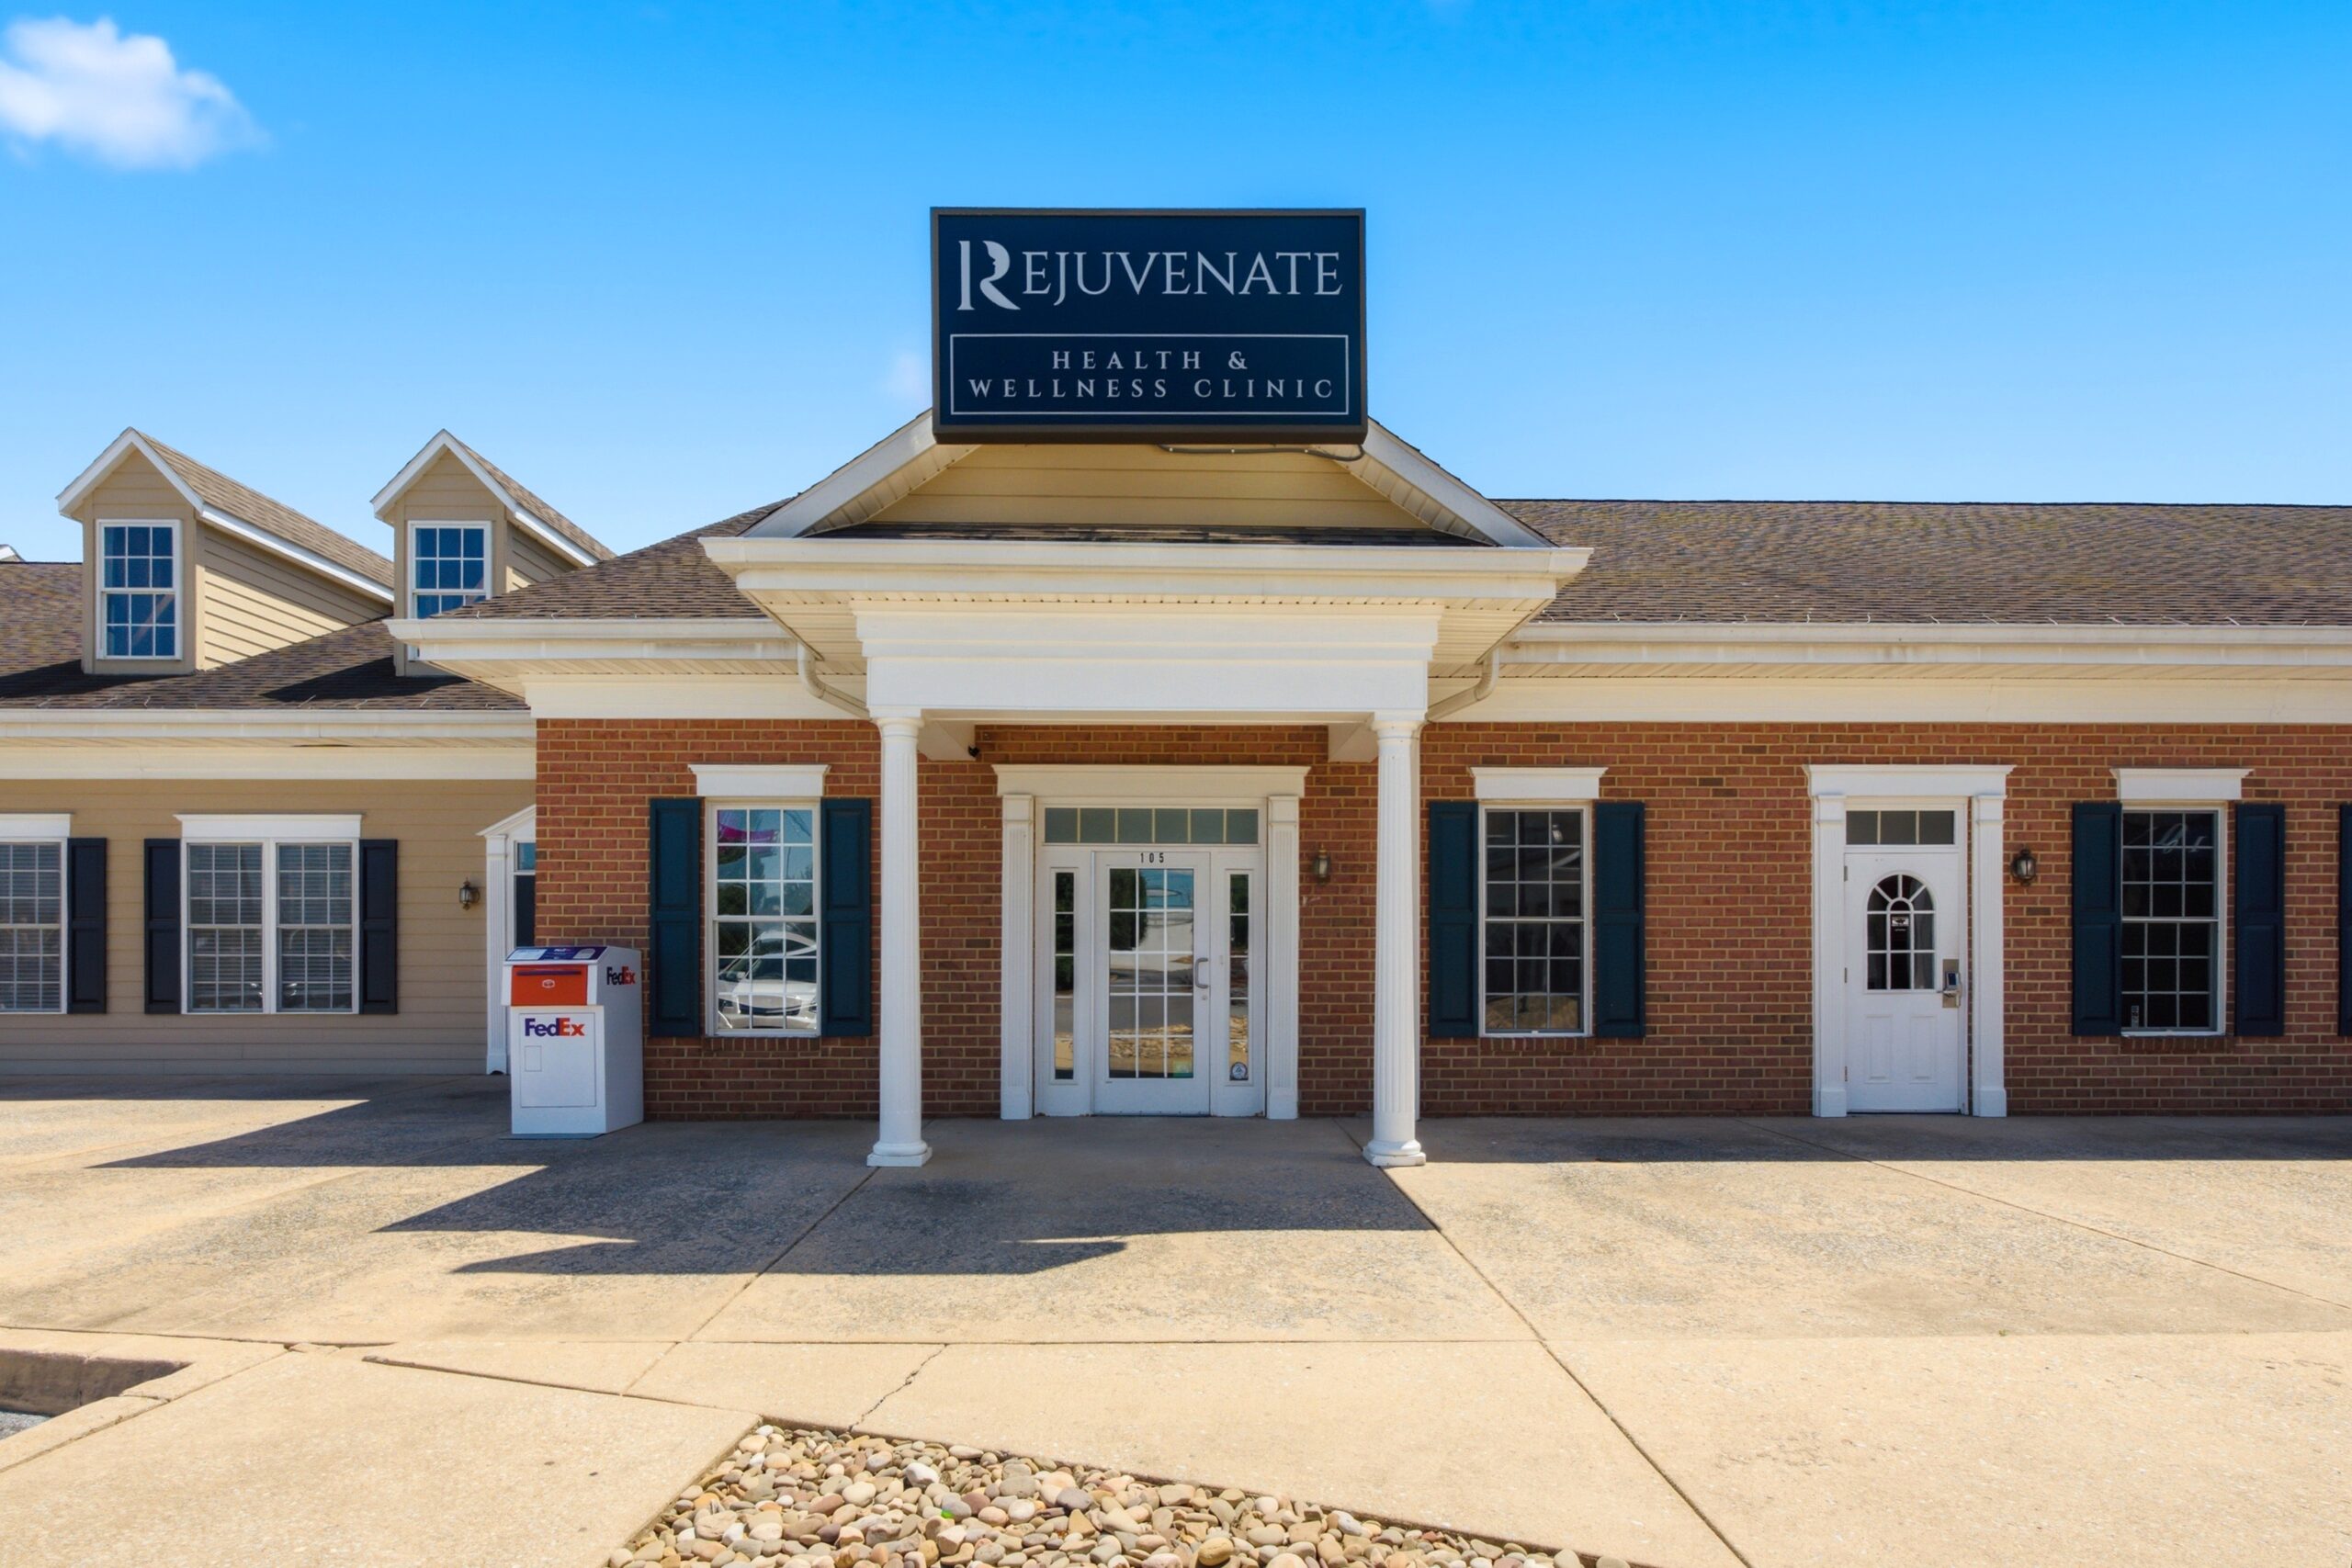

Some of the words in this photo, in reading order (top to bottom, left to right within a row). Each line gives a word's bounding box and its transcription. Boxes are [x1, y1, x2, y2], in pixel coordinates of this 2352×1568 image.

[956, 240, 1343, 310] REJUVENATE
[1052, 350, 1202, 369] HEALTH
[1227, 350, 1248, 369] &
[968, 378, 1168, 399] WELLNESS
[1193, 378, 1333, 399] CLINIC
[1140, 852, 1164, 863] 105
[606, 966, 636, 986] FedEx
[525, 1017, 585, 1037] FedEx
